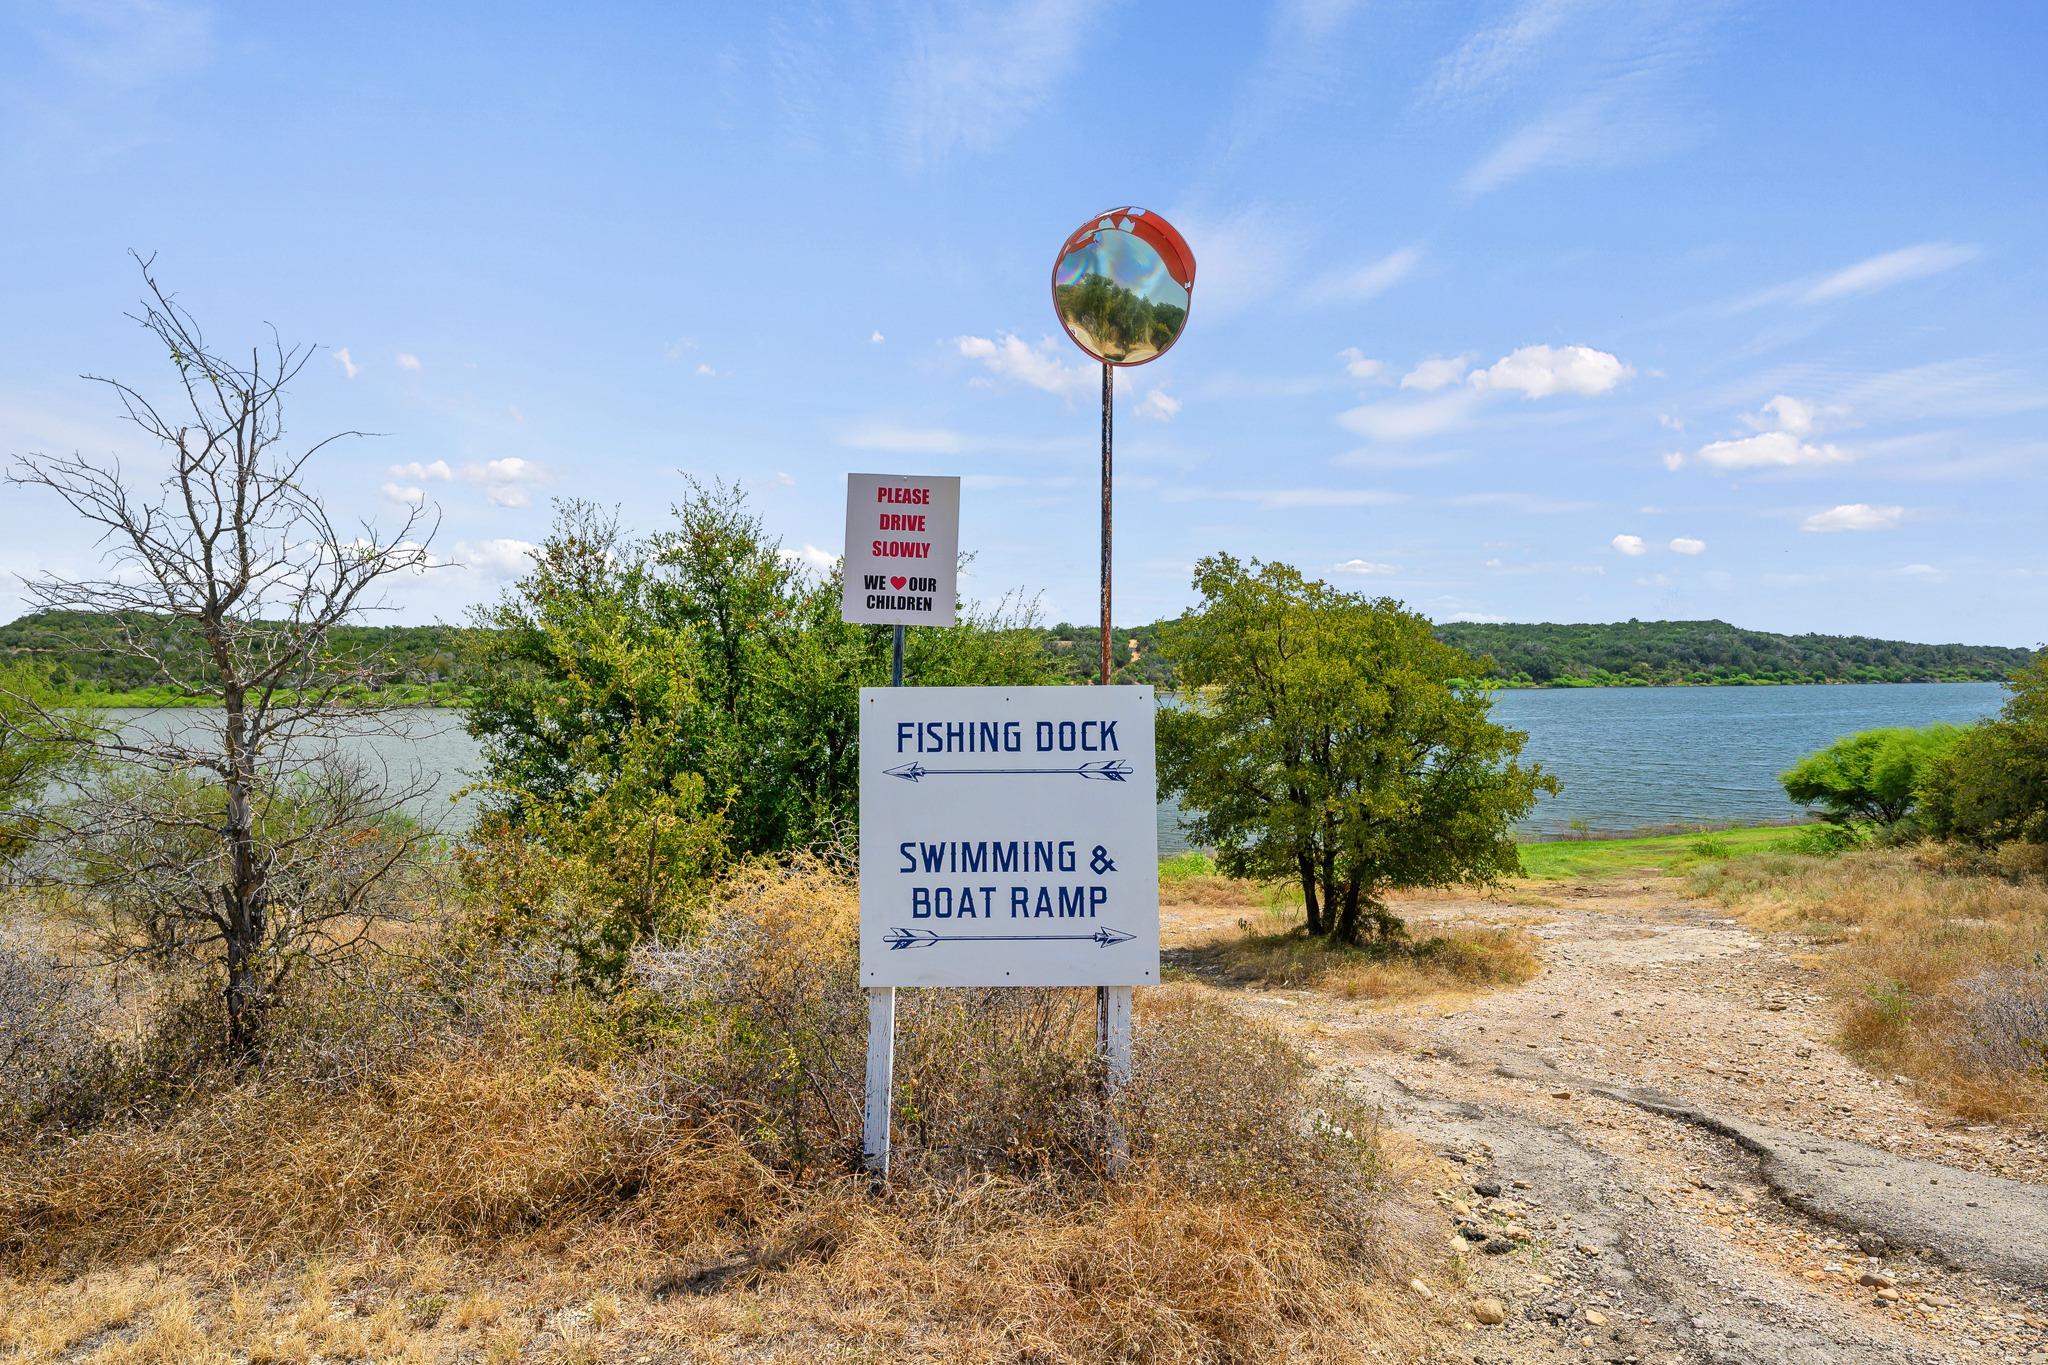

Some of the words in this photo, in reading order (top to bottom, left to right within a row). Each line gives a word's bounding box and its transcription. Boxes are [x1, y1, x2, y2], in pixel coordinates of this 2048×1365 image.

[877, 487, 930, 505] PLEASE
[879, 513, 926, 532] DRIVE
[872, 540, 931, 559] SLOWLY
[864, 574, 887, 591] WE
[908, 576, 937, 592] OUR
[866, 594, 932, 612] CHILDREN
[897, 721, 1021, 753] FISHING
[1036, 721, 1119, 752] DOCK
[900, 841, 1076, 873] SWIMMING
[1089, 845, 1119, 875] &
[912, 887, 997, 918] BOAT
[1010, 886, 1108, 918] RAMP
